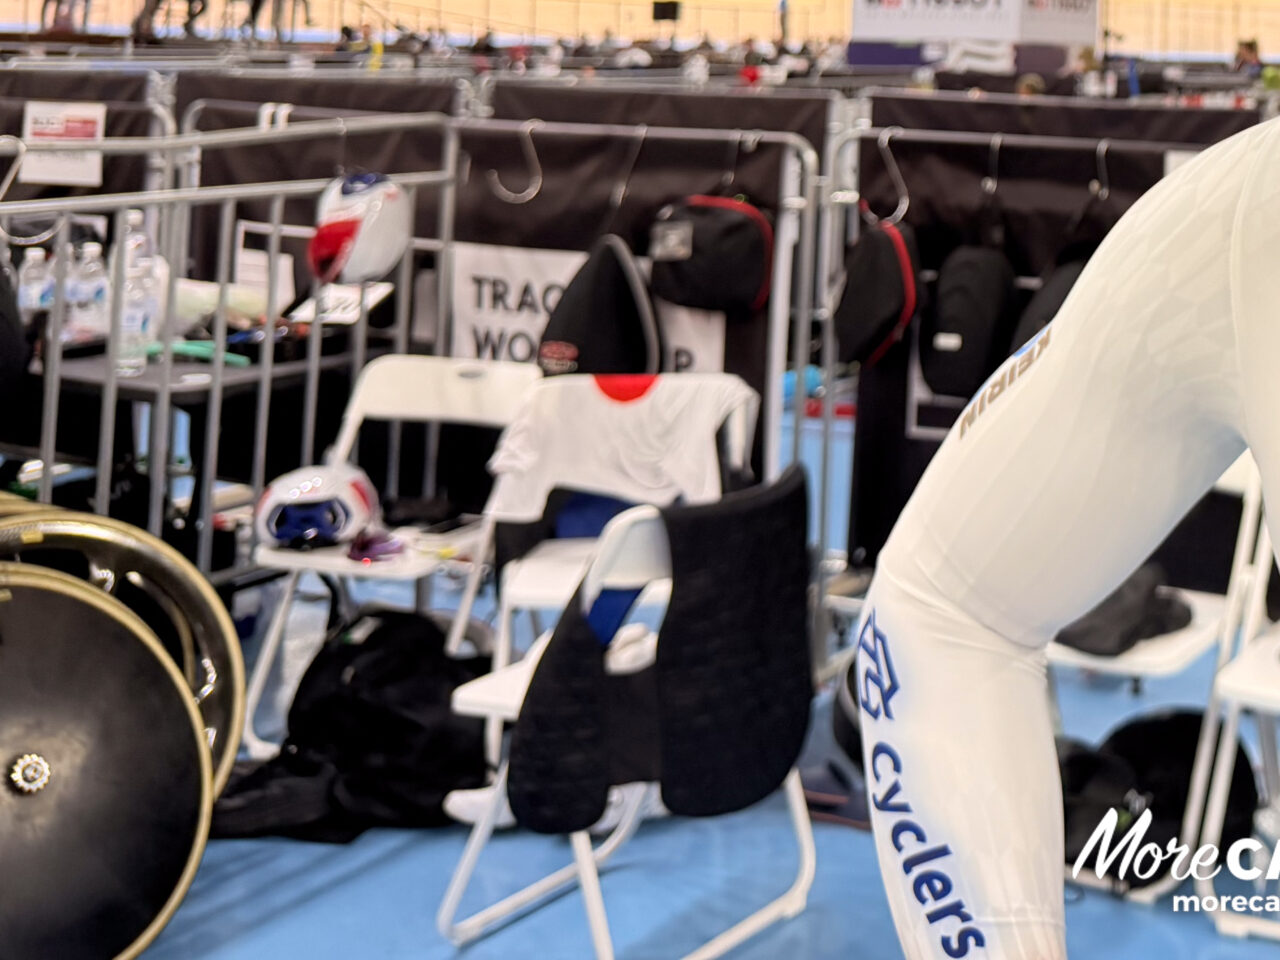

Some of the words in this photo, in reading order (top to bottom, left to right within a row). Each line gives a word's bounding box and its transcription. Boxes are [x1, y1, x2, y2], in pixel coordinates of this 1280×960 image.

[472, 275, 567, 316] TRAC
[958, 326, 1053, 441] KEIRIN
[871, 740, 986, 960] cyclers
